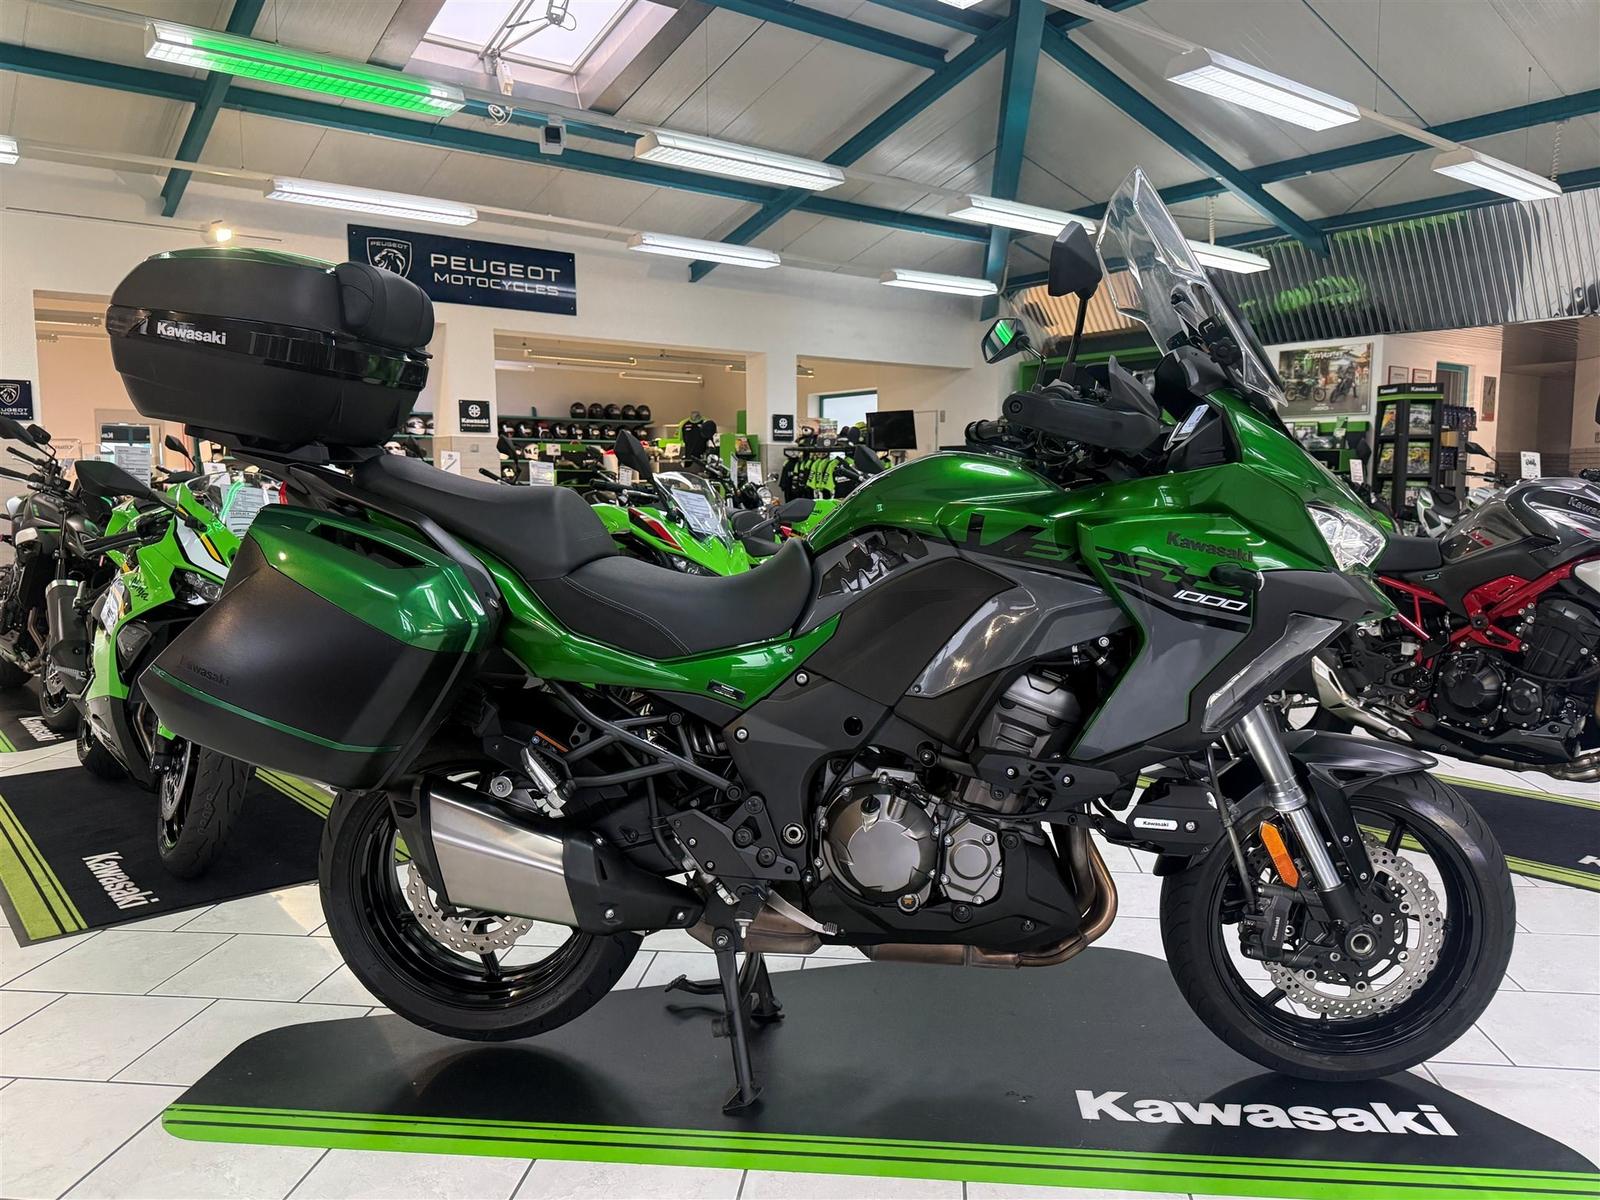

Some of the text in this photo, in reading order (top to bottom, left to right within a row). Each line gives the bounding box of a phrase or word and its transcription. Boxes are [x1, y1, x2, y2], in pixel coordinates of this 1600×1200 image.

[370, 241, 408, 249] PEUGEOT
[430, 253, 561, 282] PEUGEOT
[434, 272, 559, 296] MOTOCYCLES
[157, 322, 227, 345] Kawasaki
[1166, 532, 1254, 562] Kawasaki
[1173, 589, 1248, 611] 1000
[82, 851, 160, 910] Kawasaki
[1075, 1089, 1459, 1137] Kawasaki
